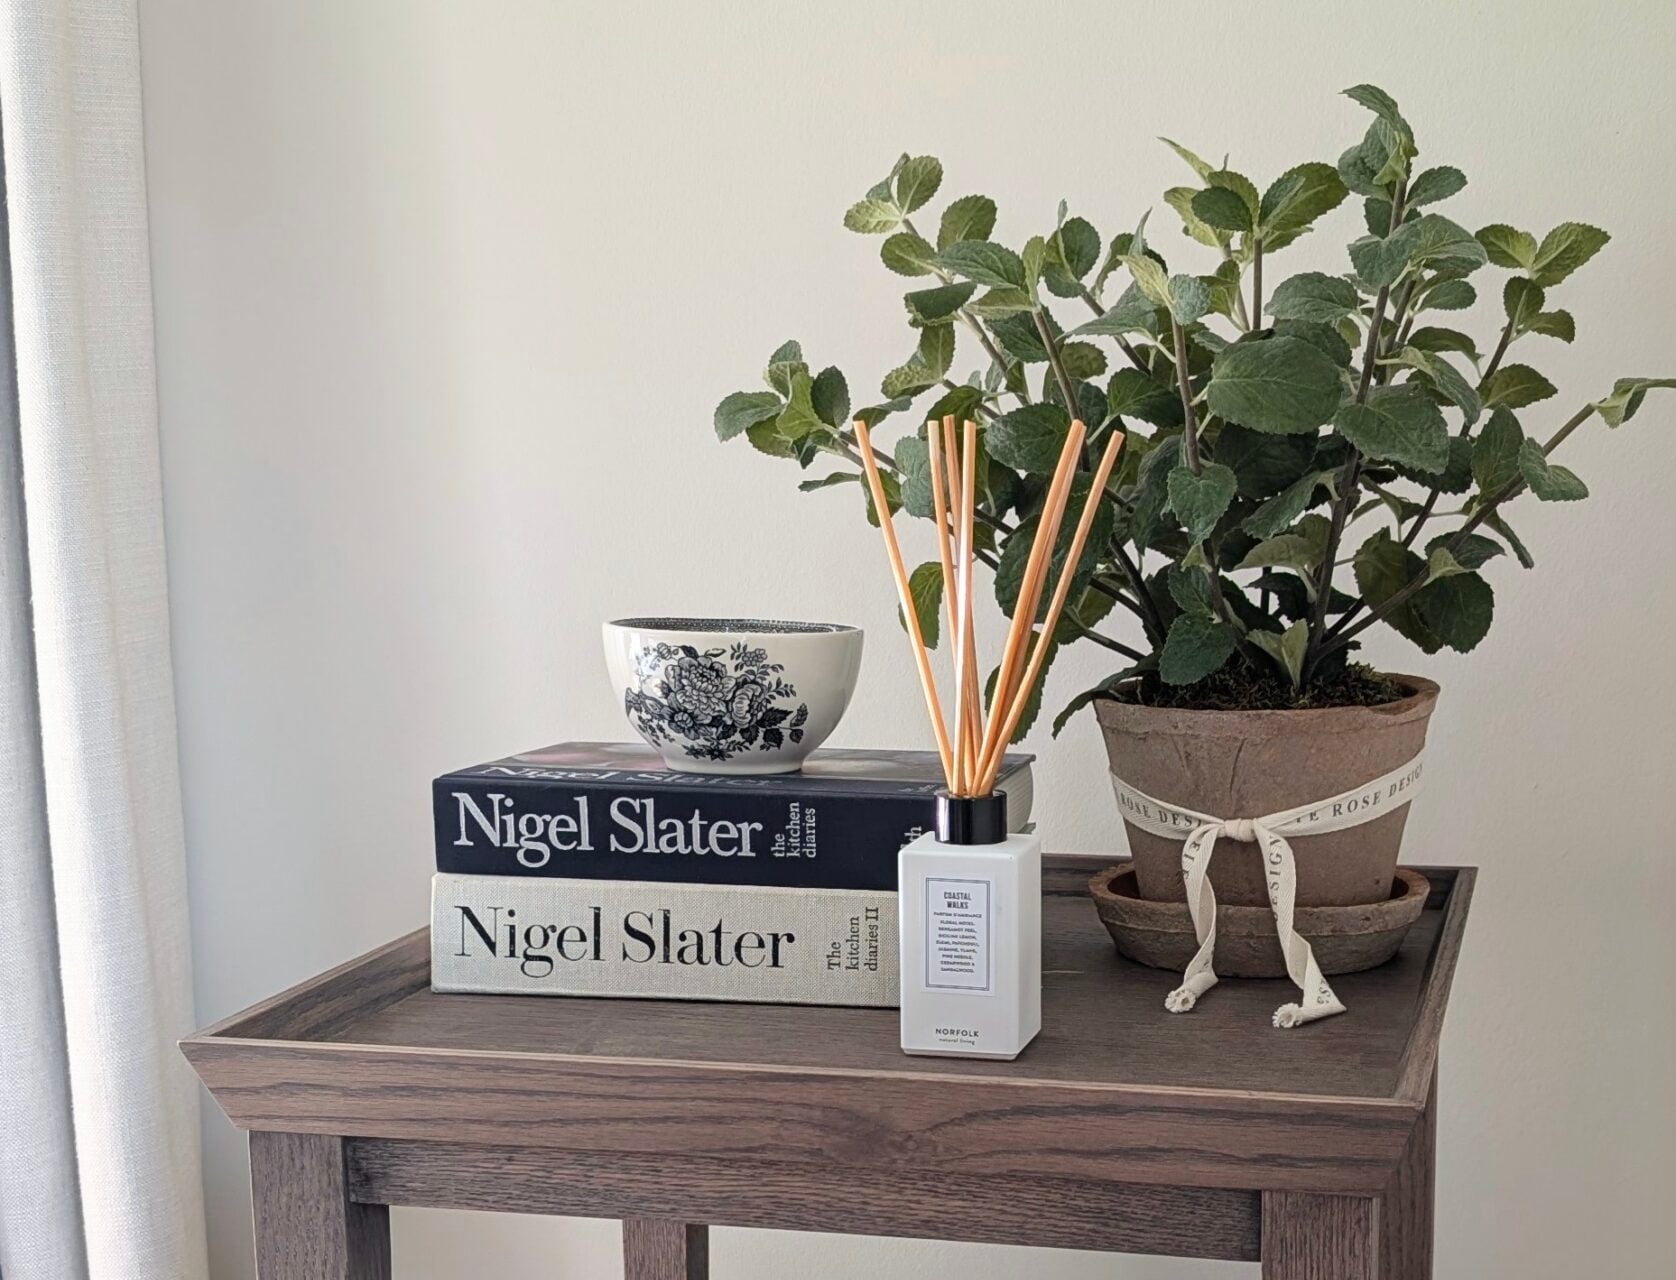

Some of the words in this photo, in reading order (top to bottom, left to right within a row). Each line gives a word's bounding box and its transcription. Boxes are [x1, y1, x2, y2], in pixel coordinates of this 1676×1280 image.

[478, 765, 620, 780] Nigel
[1333, 792, 1381, 817] ROSE
[451, 792, 594, 868] Nigel
[609, 797, 763, 857] Slater
[787, 802, 800, 858] kitchen
[803, 807, 816, 858] diaries
[772, 832, 786, 858] the
[943, 891, 972, 901] COASTAL
[946, 900, 969, 910] WALKS
[865, 907, 878, 921] II
[454, 904, 605, 978] Nigel
[622, 909, 795, 968] Slater
[845, 916, 860, 972] kitchen
[864, 921, 878, 972] diaries
[827, 941, 841, 971] The
[935, 1028, 979, 1037] NORFOLK
